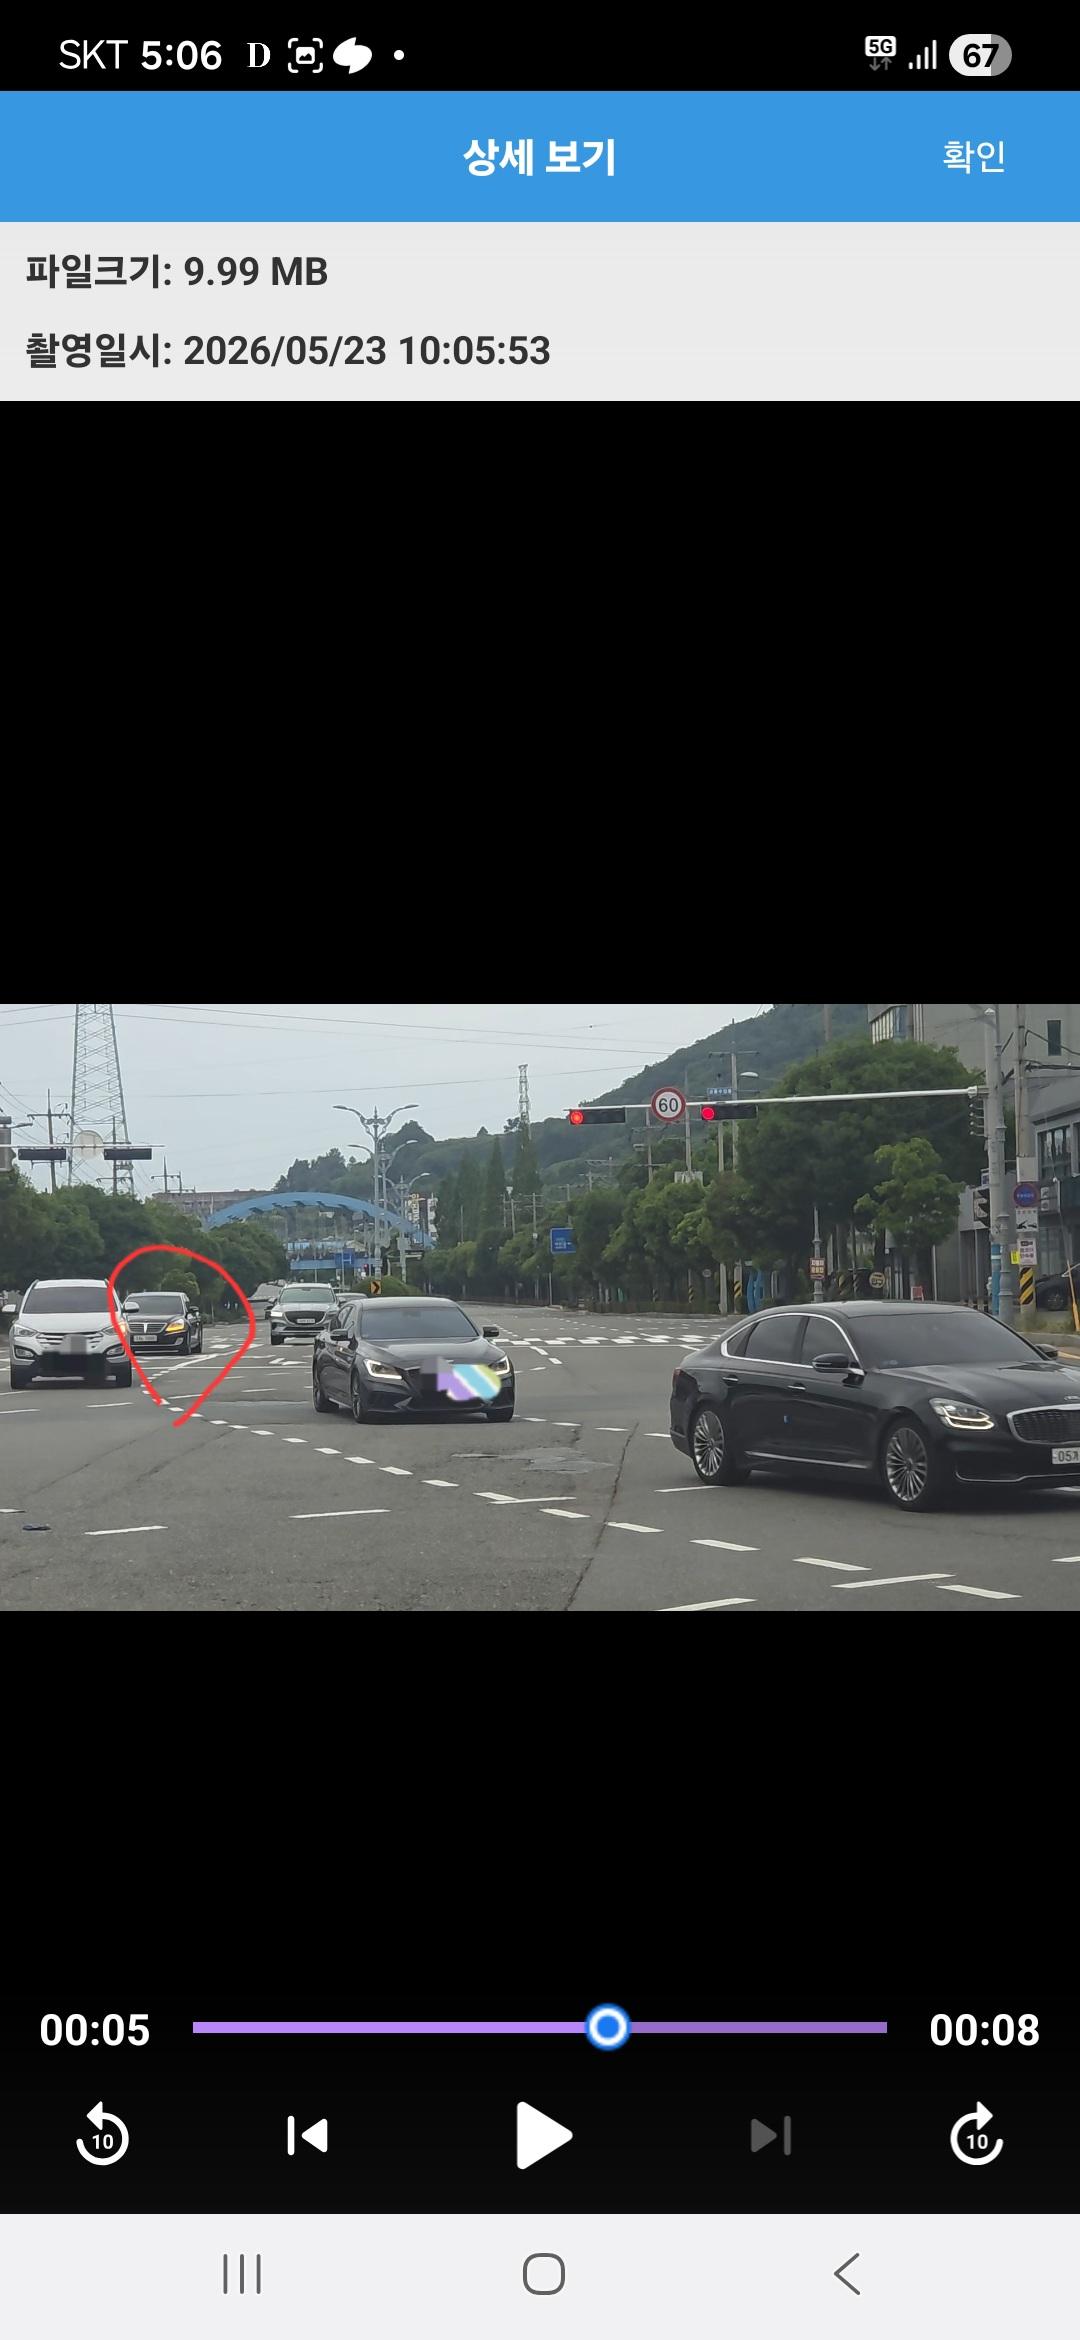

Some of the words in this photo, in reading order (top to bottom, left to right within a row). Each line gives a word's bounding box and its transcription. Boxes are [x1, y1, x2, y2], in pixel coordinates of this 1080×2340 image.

[59, 39, 128, 69] SKT
[141, 40, 222, 70] 5:06
[247, 43, 270, 67] D
[869, 39, 893, 54] 5G
[963, 43, 1000, 68] 67
[463, 139, 533, 176] 상세
[546, 139, 614, 176] 보기
[943, 141, 1004, 174] 확인
[26, 254, 171, 289] 파일크기:
[185, 257, 259, 286] 9.99
[272, 257, 327, 285] MB
[26, 333, 171, 368] 촬영일시:
[184, 336, 386, 367] 2026/05/23
[400, 336, 550, 365] 10:05:53
[659, 1098, 678, 1112] 60
[41, 2014, 149, 2046] 00:05
[931, 2014, 1039, 2046] 00:08
[93, 2134, 113, 2149] 10
[967, 2134, 988, 2149] 10
